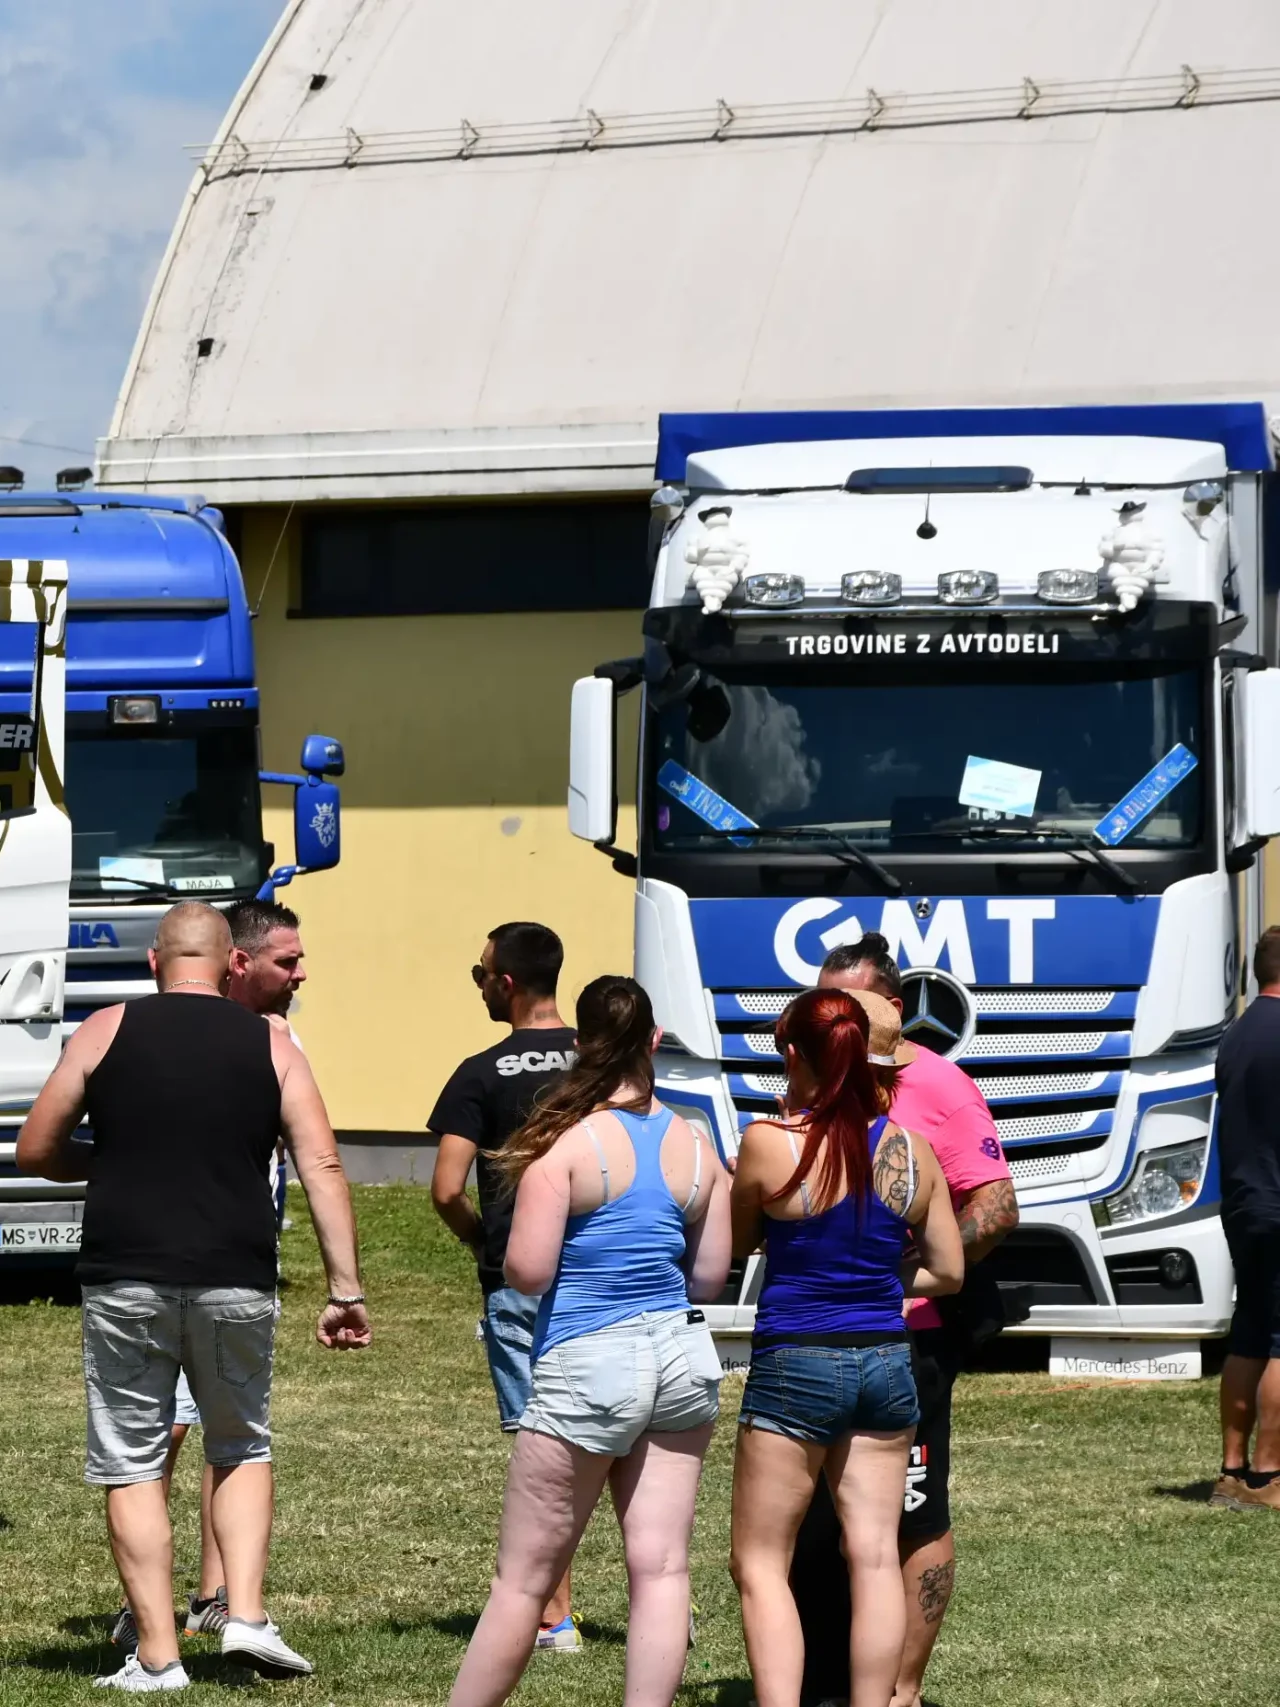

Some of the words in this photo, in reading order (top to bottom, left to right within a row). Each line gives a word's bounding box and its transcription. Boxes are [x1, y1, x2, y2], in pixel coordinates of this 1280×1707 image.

[786, 634, 907, 655] TRGOVINE
[916, 634, 931, 654] Z
[940, 633, 1059, 654] AVTODELI
[186, 879, 224, 890] MAJA
[773, 897, 1056, 987] GMT
[1, 1228, 26, 1245] MS
[1063, 1356, 1188, 1375] Mercedes-Benz
[905, 1444, 927, 1512] FILA
